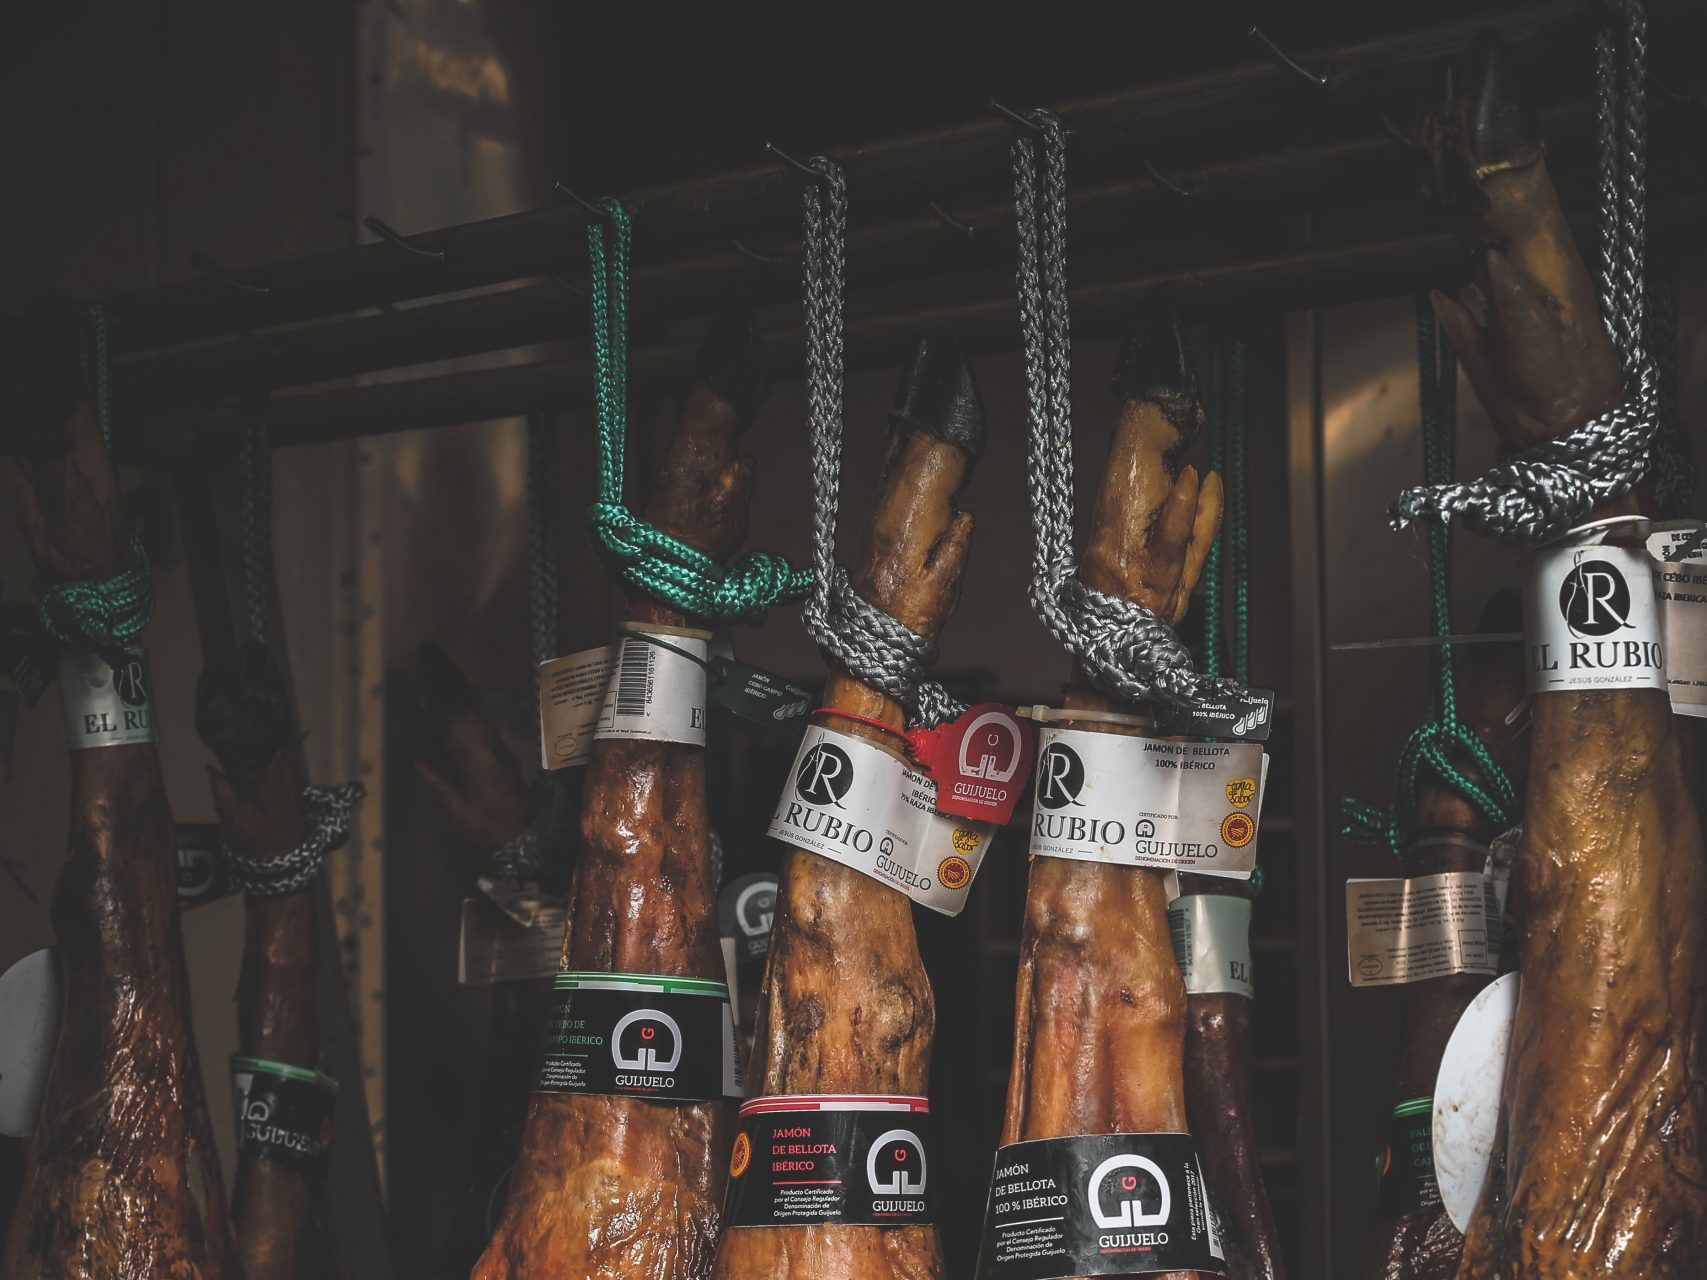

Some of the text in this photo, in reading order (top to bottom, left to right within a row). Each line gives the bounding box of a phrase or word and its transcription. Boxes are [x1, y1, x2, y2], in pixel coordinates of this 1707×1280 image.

[1531, 641, 1663, 673] EL RUBIO
[1594, 675, 1632, 684] GONZÁLEZ
[1239, 696, 1269, 705] uijuelo
[83, 710, 151, 735] EL RU
[1143, 743, 1230, 756] JAMON DE BELLOTA
[1155, 759, 1215, 771] 100% IBÉRICO
[924, 780, 934, 790] DE
[954, 782, 1007, 801] GUIJUELO
[910, 797, 926, 812] RAZA
[784, 801, 873, 853] RUBIO
[1033, 813, 1125, 845] RUBIO
[795, 835, 825, 849] GONZÁLEZ
[1136, 840, 1218, 858] GUIJUELO
[876, 855, 931, 891] GUIJUELO
[1230, 961, 1248, 983] EL
[575, 1020, 585, 1029] DE
[615, 1075, 675, 1088] GUIJUELO
[773, 1127, 811, 1138] JAMÓN
[772, 1144, 836, 1155] DE BELLOTA
[772, 1161, 814, 1172] IBÉRICO
[995, 1163, 1029, 1180] JAMÓN
[995, 1179, 1056, 1197] DE BELLOTA
[812, 1195, 840, 1203] Regulador
[995, 1195, 1068, 1214] 100 % IBÉRICO
[872, 1200, 925, 1212] GUIJUELO
[1001, 1226, 1056, 1239] Producto Certificado
[1012, 1237, 1034, 1245] Consejo
[1034, 1233, 1063, 1242] Regulador
[1098, 1233, 1168, 1248] GUIJUELO
[1006, 1243, 1044, 1253] Denominación
[997, 1248, 1066, 1262] Origen Protegida Guijuelo
